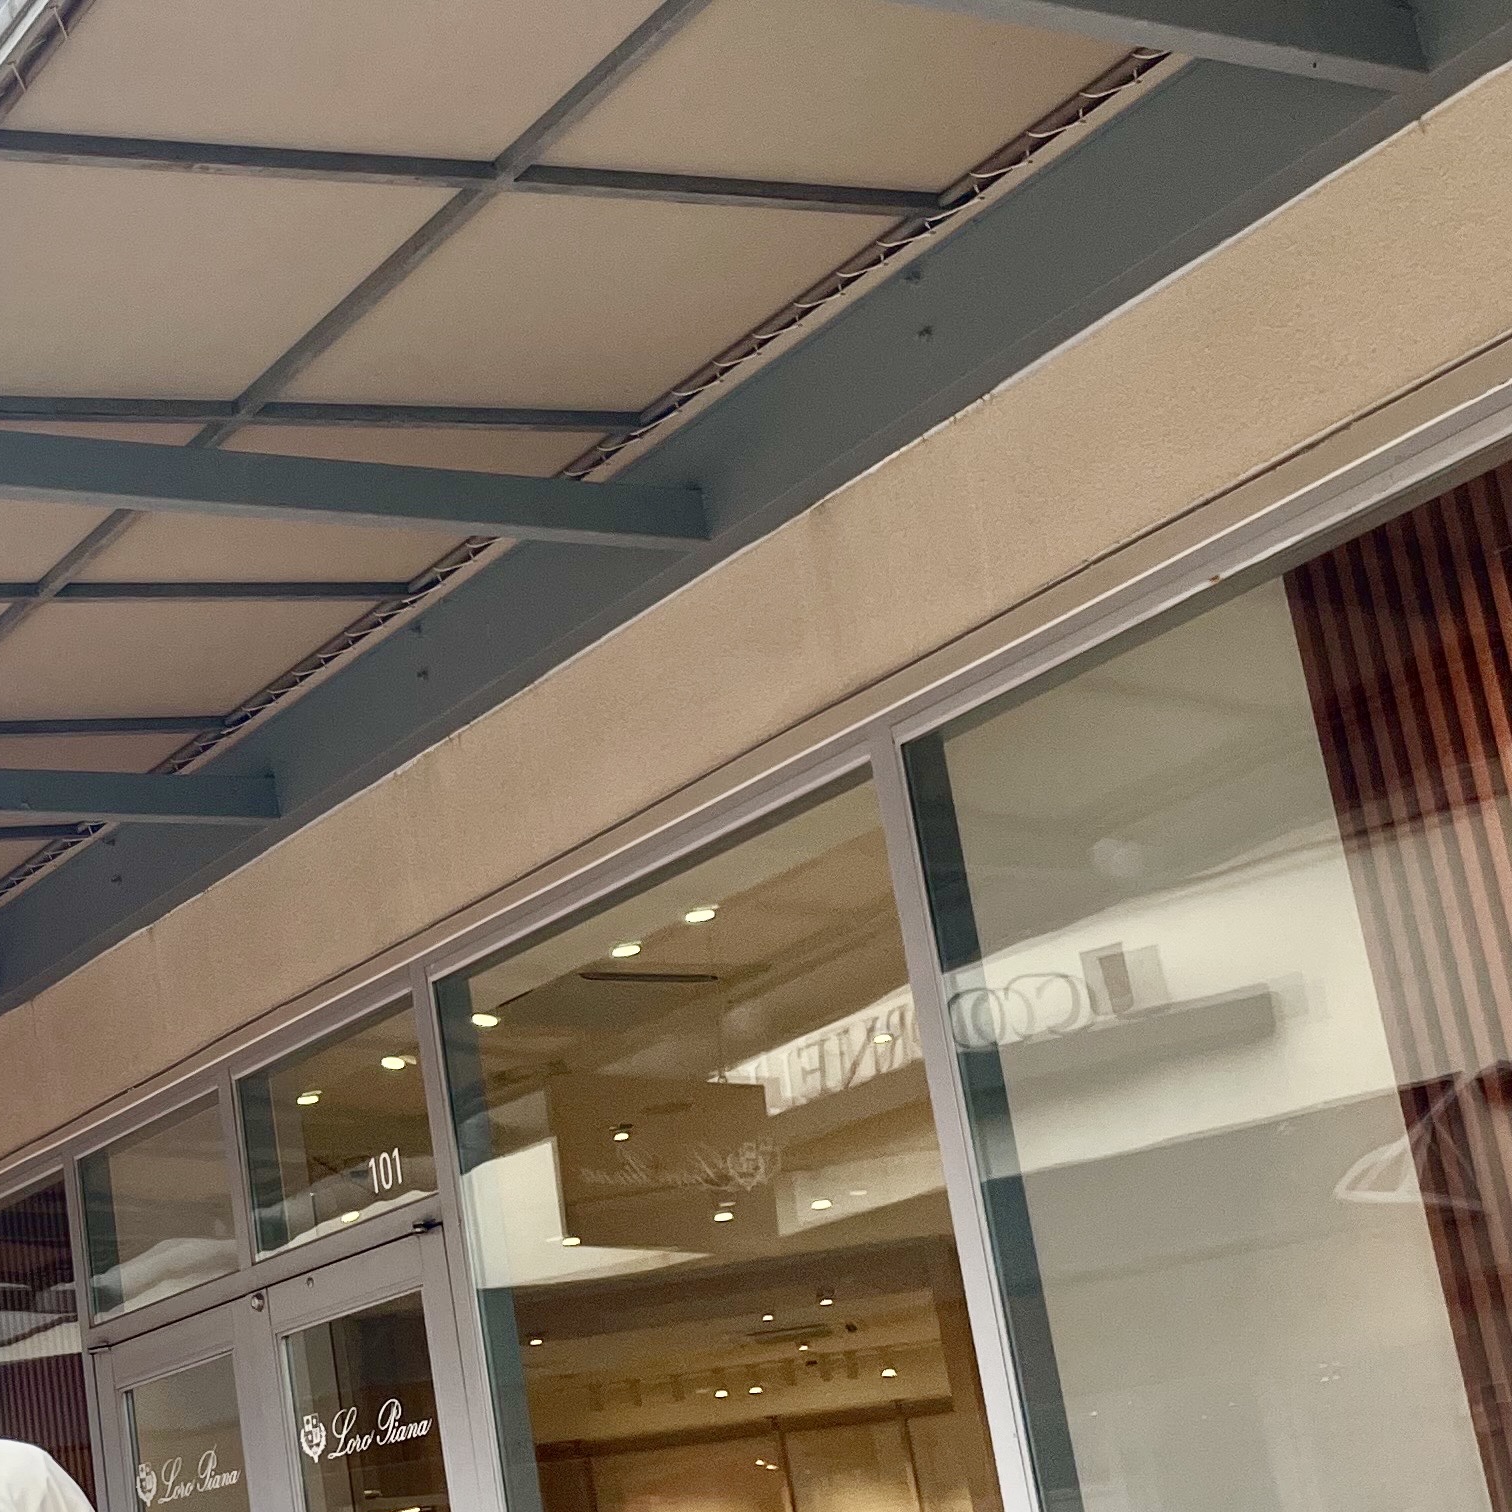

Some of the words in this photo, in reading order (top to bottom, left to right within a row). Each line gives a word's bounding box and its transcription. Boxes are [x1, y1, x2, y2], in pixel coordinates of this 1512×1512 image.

[368, 1147, 403, 1194] 101
[327, 1405, 375, 1459] Loro
[376, 1398, 433, 1446] Piana
[157, 1456, 196, 1505] Loro
[196, 1443, 241, 1494] Piana
